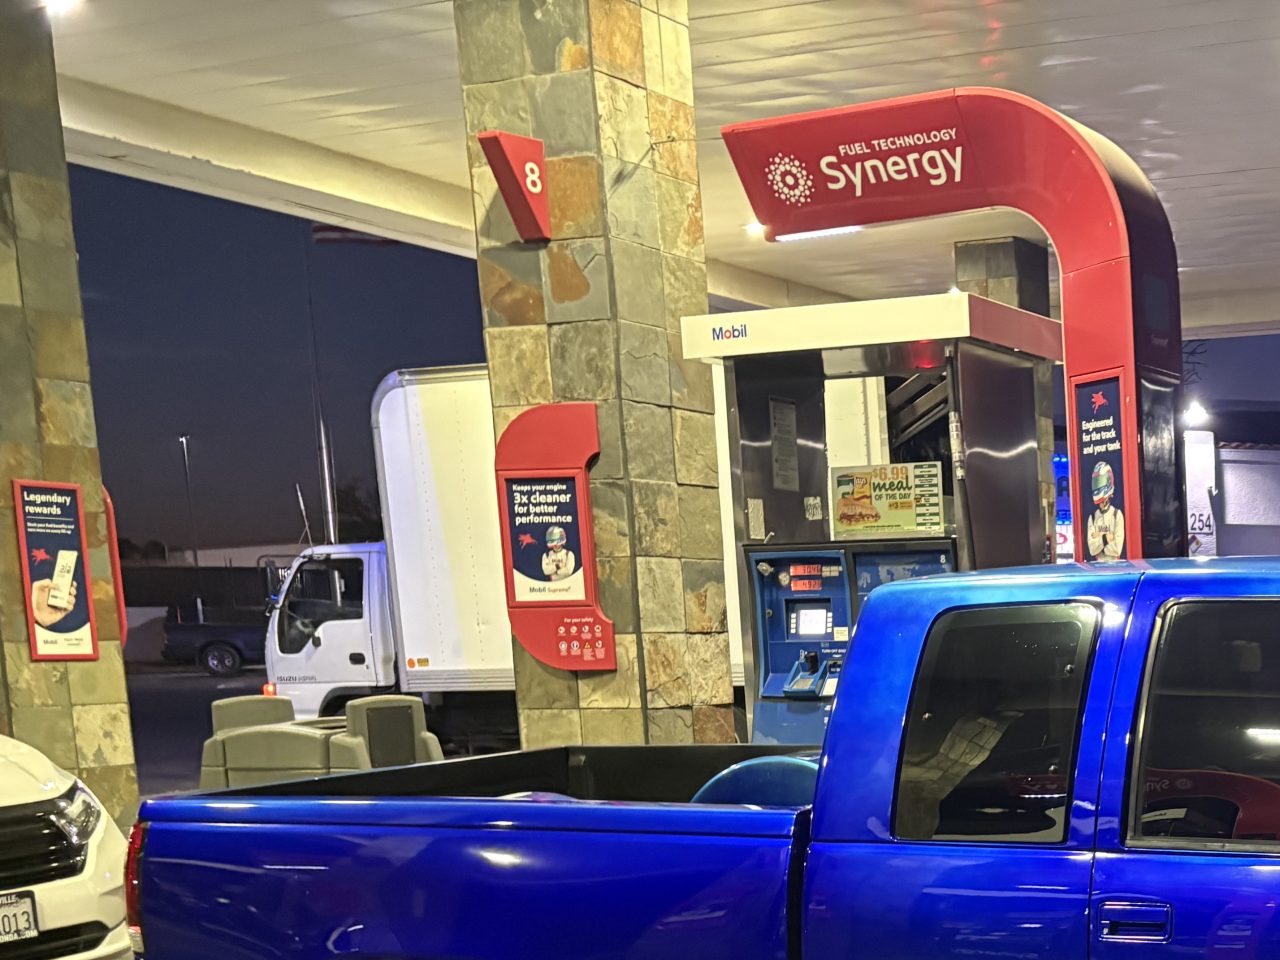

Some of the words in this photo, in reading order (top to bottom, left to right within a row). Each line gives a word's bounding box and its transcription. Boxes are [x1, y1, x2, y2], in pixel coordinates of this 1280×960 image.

[838, 142, 870, 156] FUEL
[871, 128, 957, 151] TECHNOLOGY
[524, 161, 542, 193] 8
[819, 146, 963, 197] Synergy
[712, 324, 747, 341] Mobil
[1081, 415, 1113, 431] Engineered
[1082, 432, 1091, 442] for
[1091, 431, 1101, 441] the
[1101, 428, 1116, 439] track
[1083, 443, 1093, 454] and
[1093, 444, 1107, 455] your
[1107, 440, 1121, 451] tank
[872, 466, 909, 481] $6.99
[512, 483, 531, 493] Keeps
[531, 484, 546, 492] your
[545, 482, 567, 492] engine
[872, 474, 912, 492] meal
[24, 491, 71, 506] Legendary
[513, 492, 529, 503] 3x
[530, 491, 572, 503] cleaner
[898, 492, 912, 500] DAY
[25, 505, 61, 515] rewards
[514, 504, 528, 513] for
[529, 503, 558, 513] better
[515, 513, 573, 526] performance
[1190, 513, 1211, 531] 254
[940, 554, 946, 564] 8
[0, 910, 31, 934] 013
